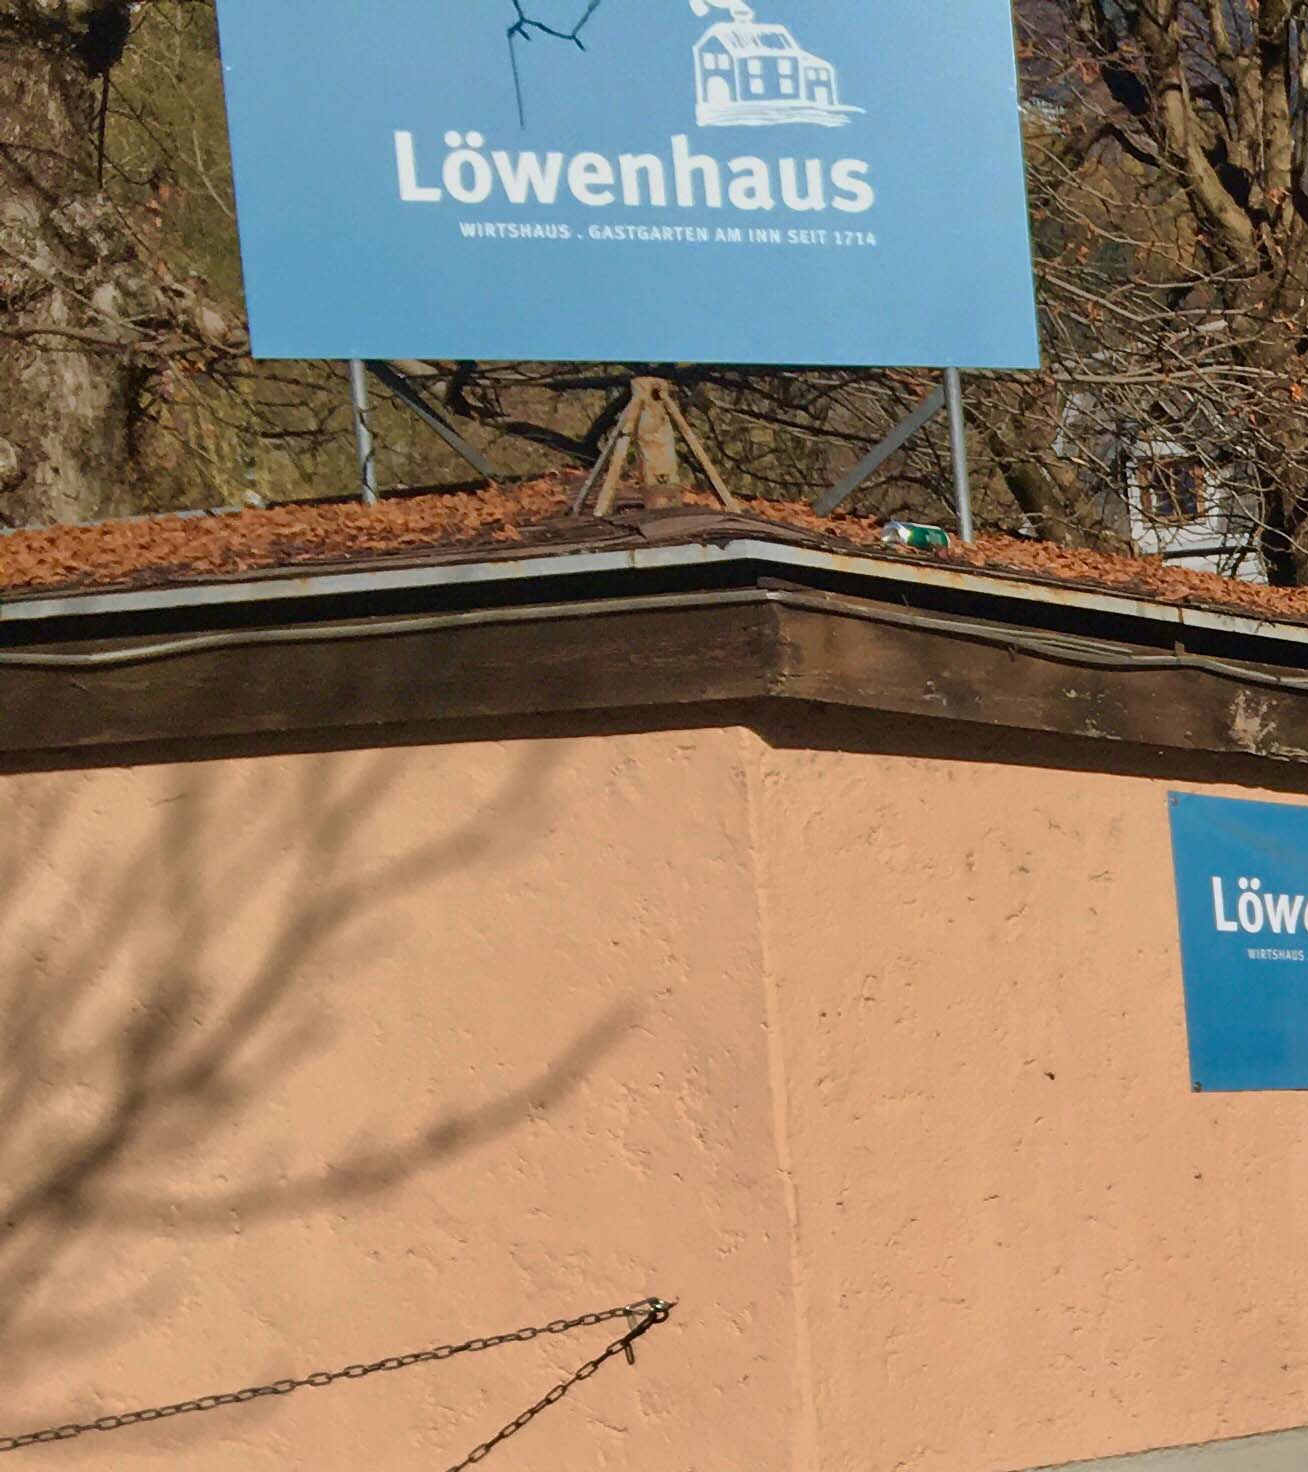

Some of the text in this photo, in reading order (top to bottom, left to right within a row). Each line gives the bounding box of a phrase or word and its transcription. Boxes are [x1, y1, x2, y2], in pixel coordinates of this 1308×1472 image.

[394, 130, 875, 212] Löwenhaus
[459, 222, 877, 246] WIRTSHAUS GASTGARTEN AM INN SEIT 1714
[1247, 948, 1305, 961] WIRTSHAUS
